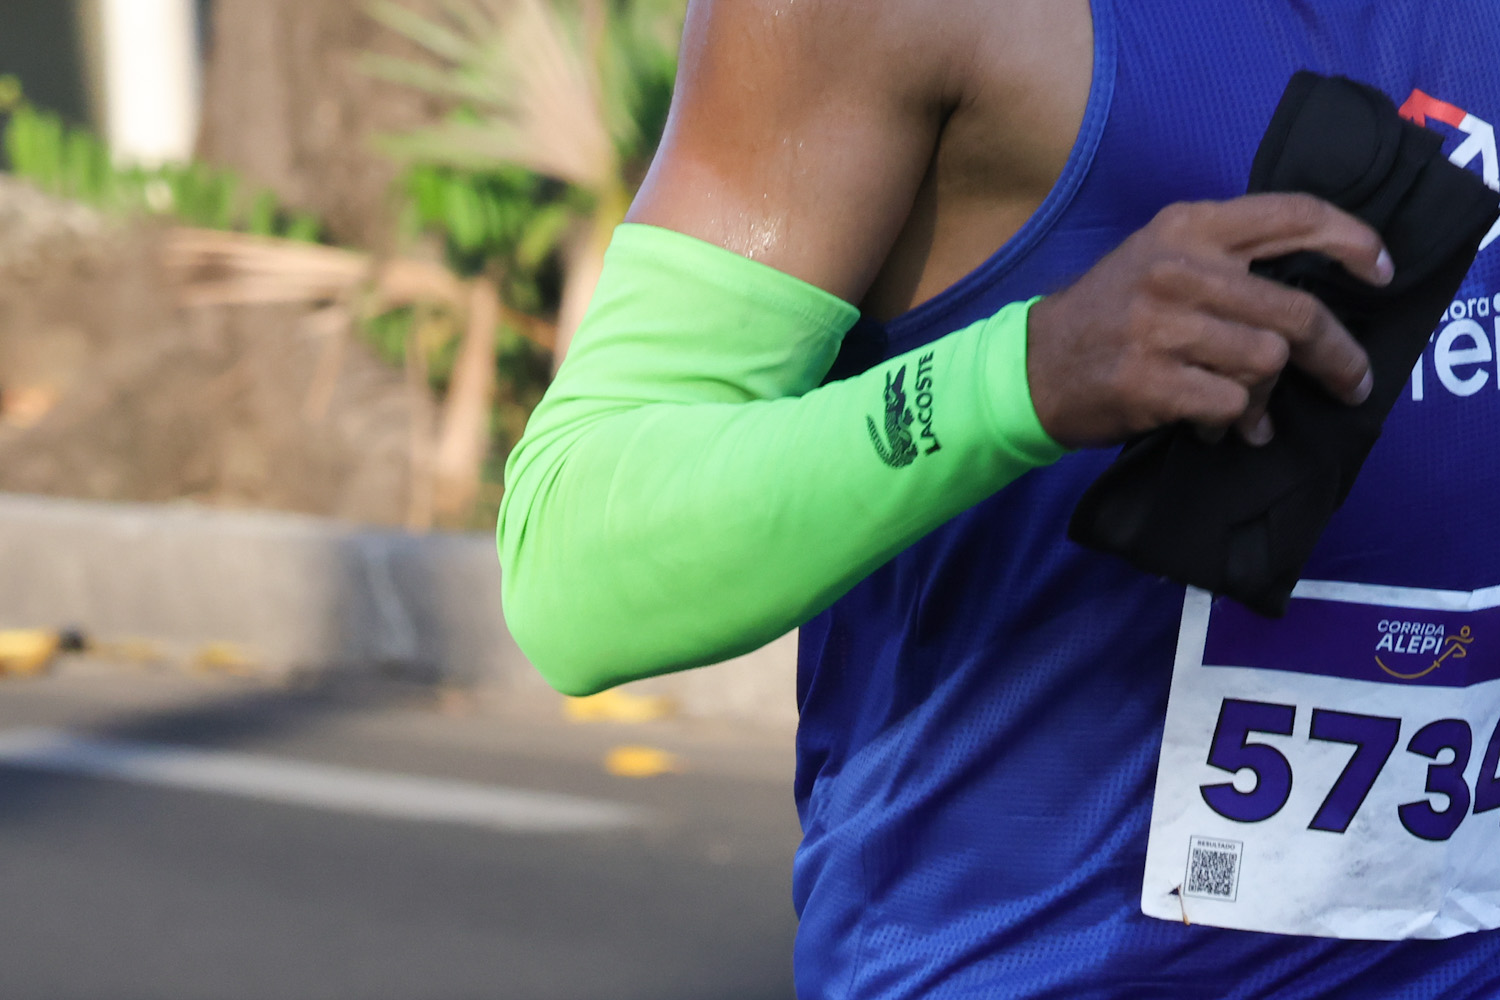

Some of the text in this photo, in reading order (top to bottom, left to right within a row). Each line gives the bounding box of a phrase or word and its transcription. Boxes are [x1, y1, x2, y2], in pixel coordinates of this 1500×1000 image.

[915, 350, 942, 456] LACOSTE
[1377, 619, 1445, 636] CORRIDA
[1375, 633, 1443, 655] ALEPI
